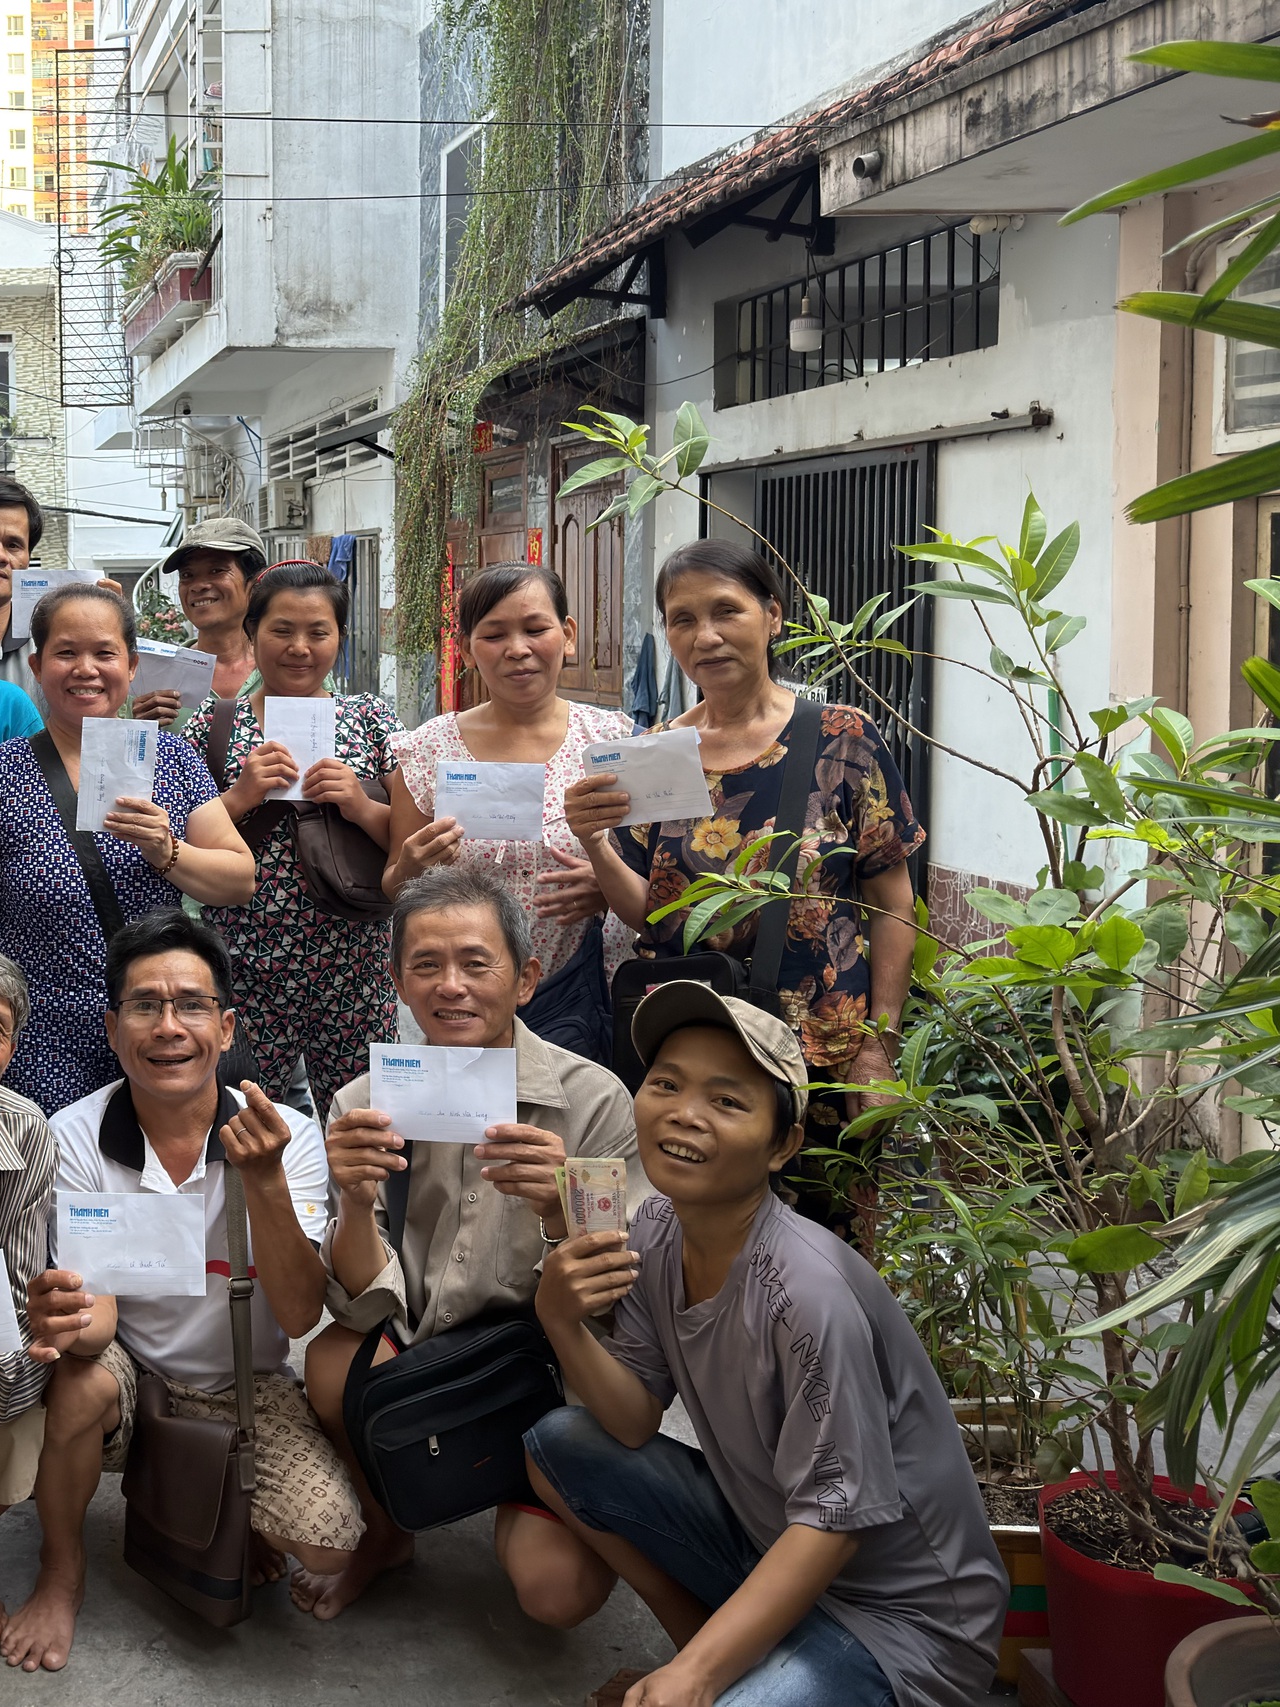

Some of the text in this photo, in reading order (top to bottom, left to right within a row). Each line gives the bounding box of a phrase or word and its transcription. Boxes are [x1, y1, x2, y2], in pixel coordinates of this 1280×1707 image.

[69, 1208, 93, 1218] THANH
[749, 1242, 793, 1323] NKE
[790, 1333, 832, 1422] NIKE
[812, 1440, 848, 1525] NIKE
